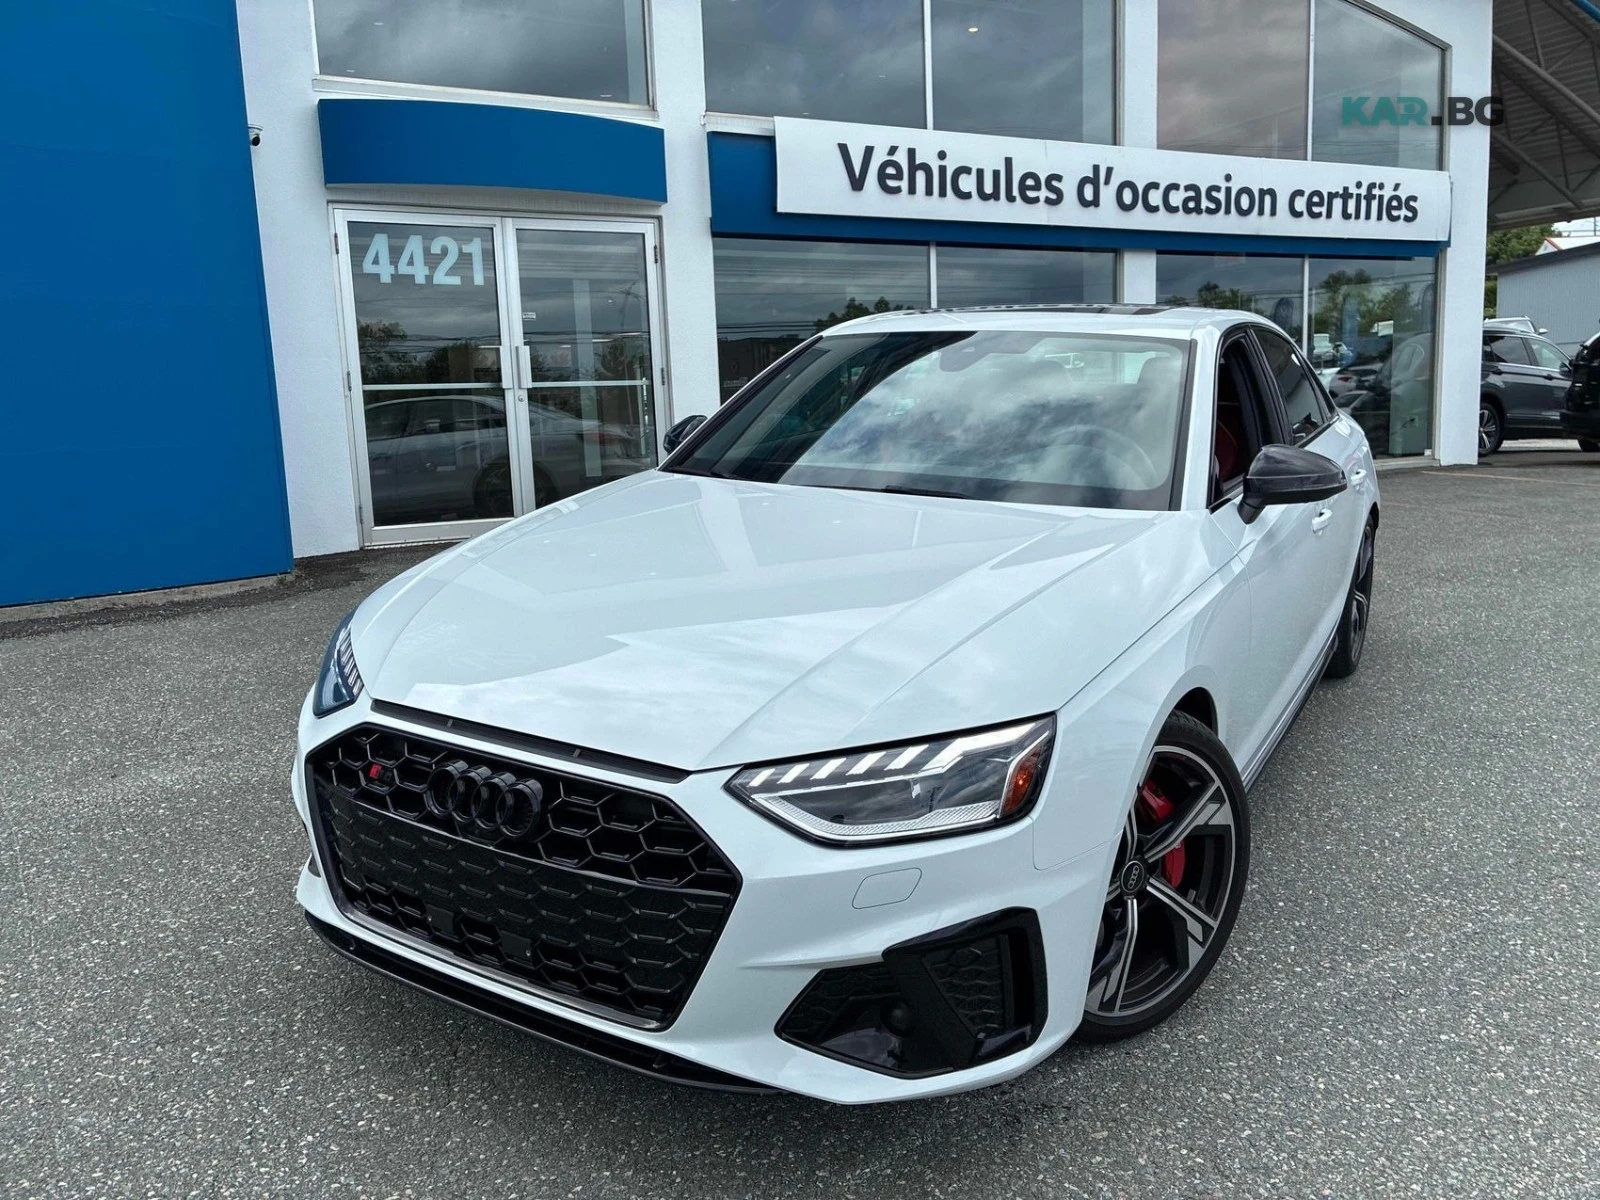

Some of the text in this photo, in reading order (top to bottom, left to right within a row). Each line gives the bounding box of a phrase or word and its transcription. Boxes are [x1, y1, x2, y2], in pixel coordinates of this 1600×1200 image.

[838, 143, 1420, 224] Véhicules d'occasion certifiés
[362, 233, 485, 286] 4421
